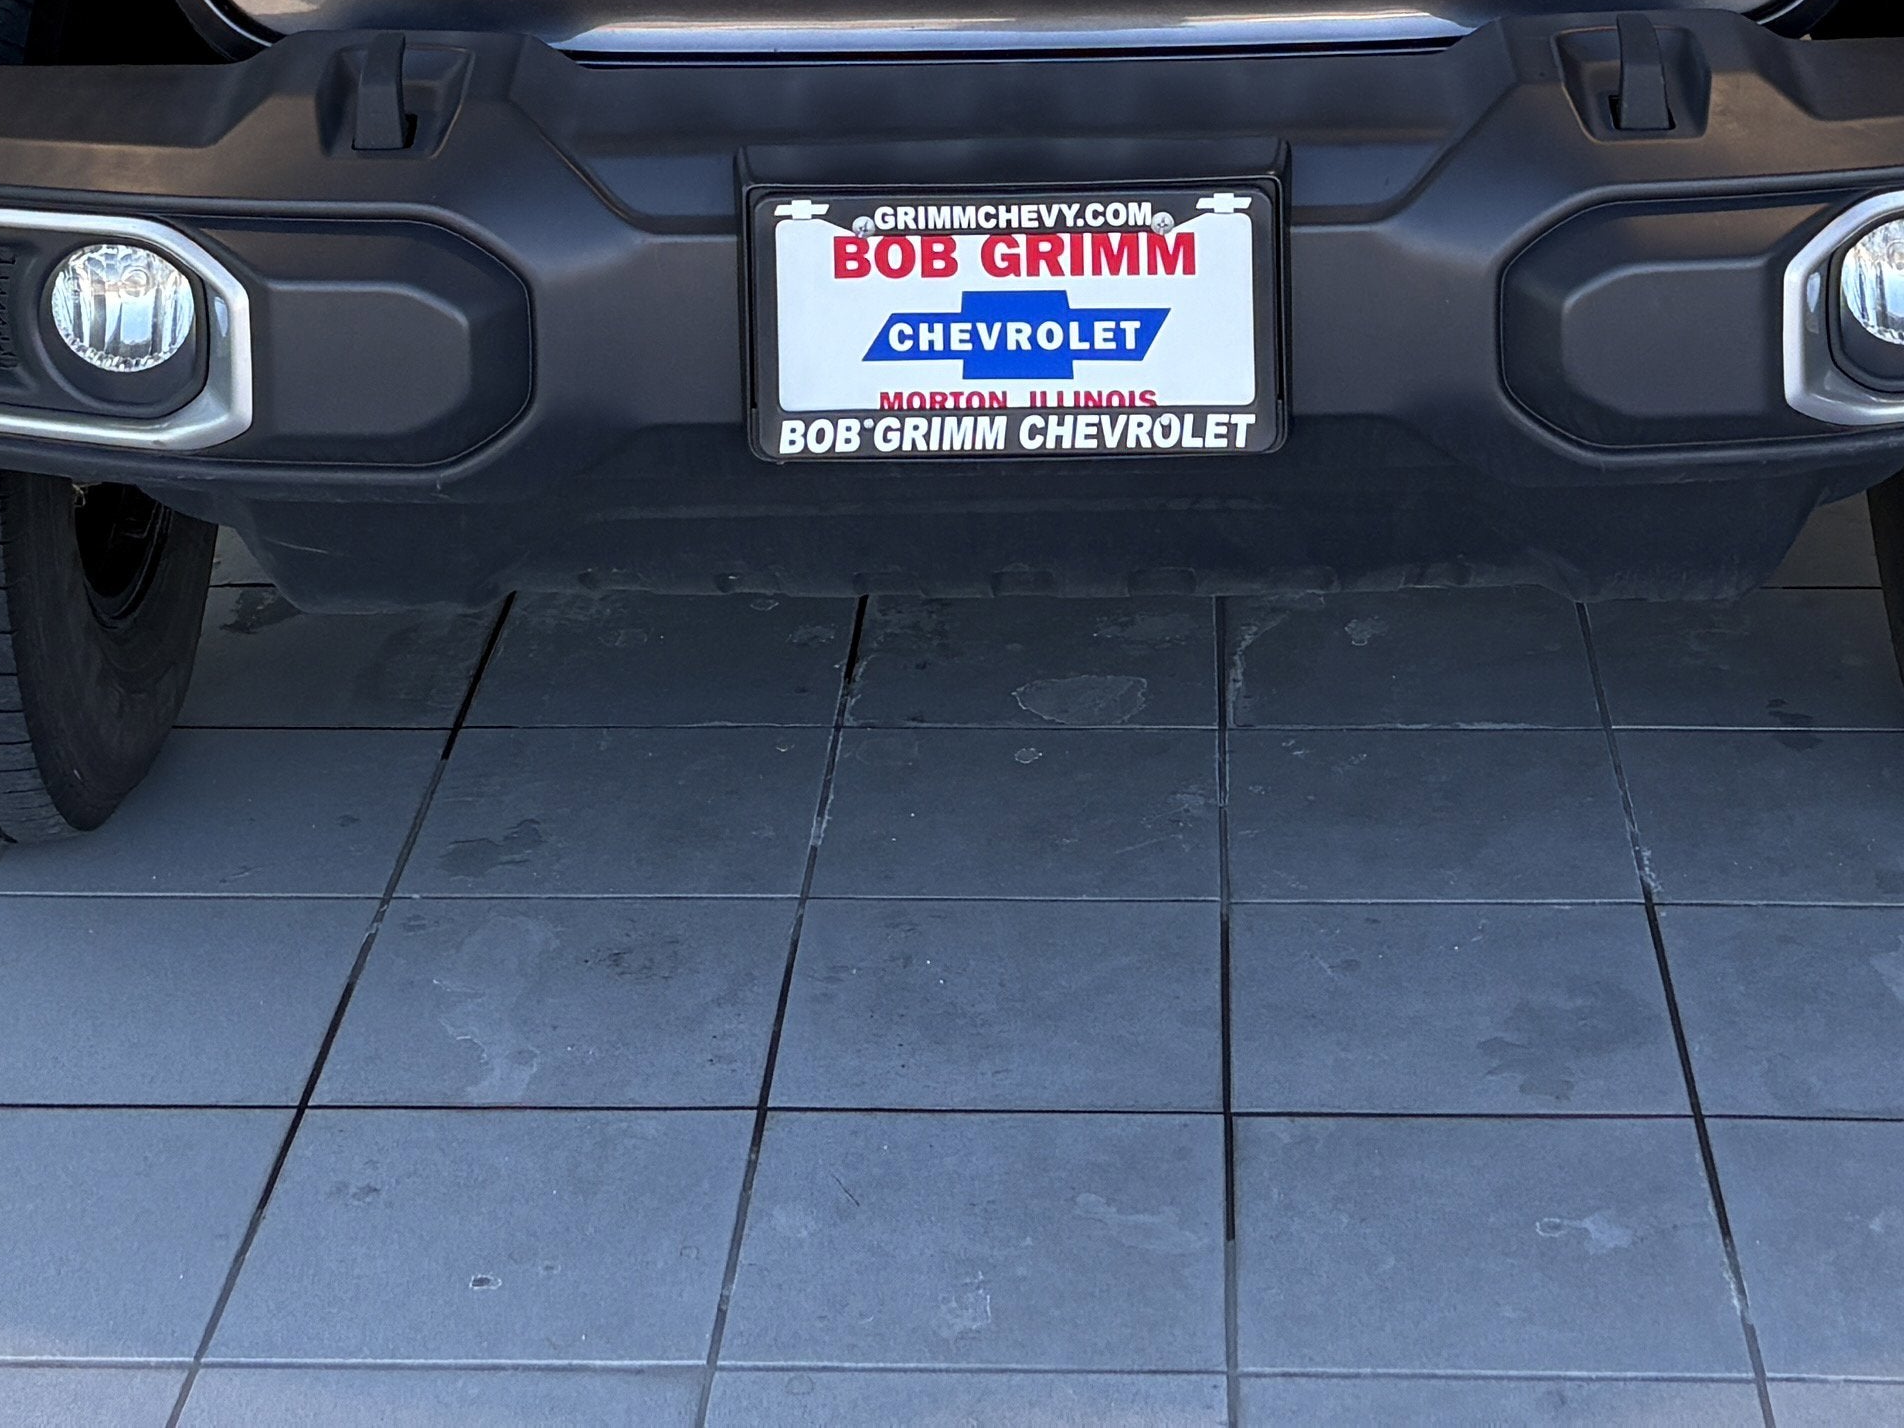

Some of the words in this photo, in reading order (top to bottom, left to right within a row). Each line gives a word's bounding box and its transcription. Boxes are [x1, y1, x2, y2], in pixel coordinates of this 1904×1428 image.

[873, 201, 1152, 230] GRIMMCHEVY.COM
[834, 235, 958, 279] BOB
[980, 232, 1196, 278] GRIMM
[887, 319, 1141, 352] CHEVROLET
[879, 391, 1007, 410] MORTON
[1029, 389, 1157, 408] ILLINOIS
[779, 417, 862, 455] BOB
[872, 415, 1007, 452] GRIMM
[1018, 412, 1256, 451] CHEVROLET
